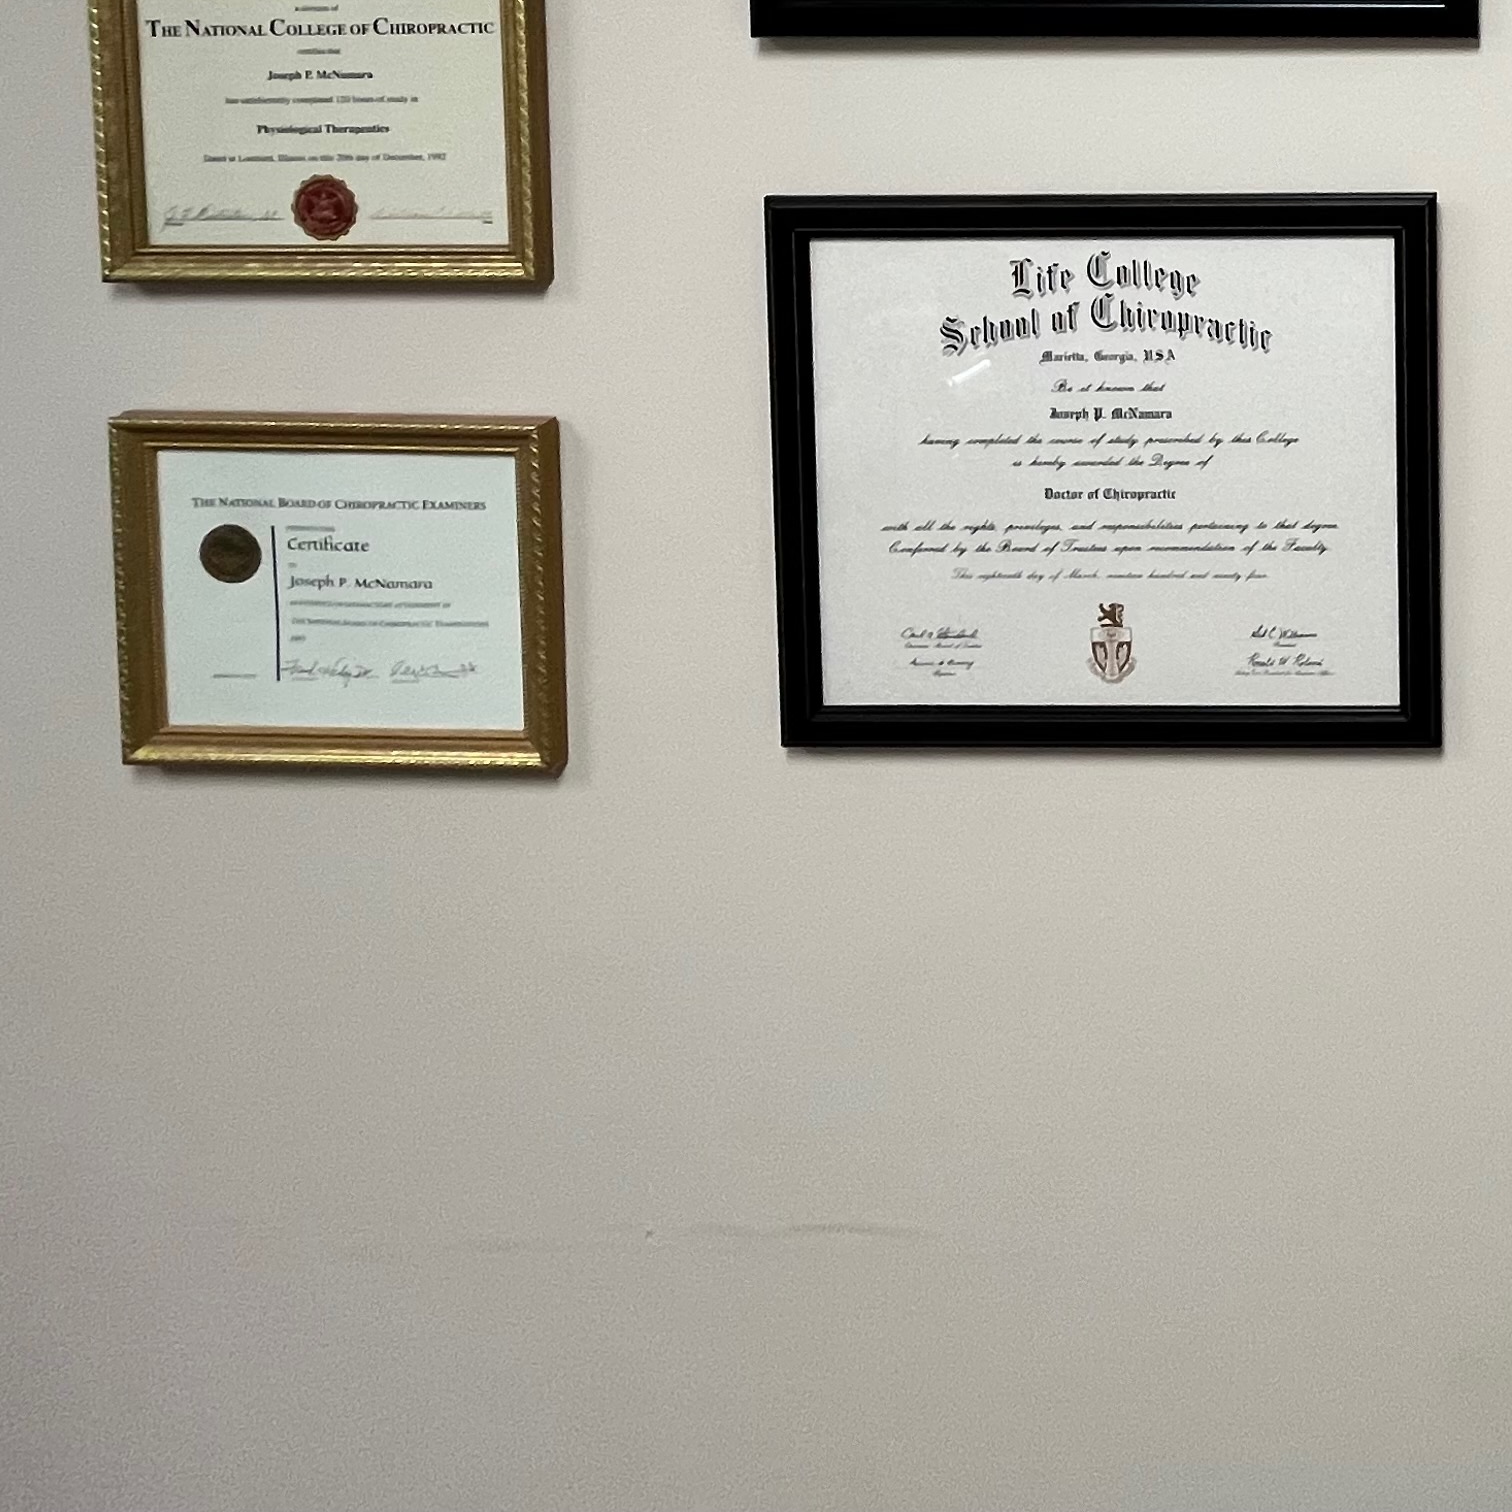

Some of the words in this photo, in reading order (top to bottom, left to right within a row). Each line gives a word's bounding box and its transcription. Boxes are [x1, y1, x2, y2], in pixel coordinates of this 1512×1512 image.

[145, 20, 181, 37] THE
[185, 20, 267, 36] NATIONAL
[270, 19, 347, 36] COLLEGE
[350, 24, 370, 35] OF
[373, 18, 493, 35] CHIROPRACTIC
[1010, 258, 1074, 299] Life
[1087, 251, 1200, 303] College
[940, 308, 1039, 356] School
[1052, 302, 1080, 334] of
[1091, 290, 1272, 357] Chiropractic
[1050, 408, 1089, 422] Joseph
[1112, 407, 1172, 419] McNamara
[1025, 434, 1042, 444] the
[1088, 433, 1107, 448] of
[1105, 433, 1138, 448] study
[1208, 433, 1223, 448] by
[1045, 488, 1083, 499] Doctor
[1088, 488, 1100, 499] of
[1103, 488, 1176, 501] Chiropractic
[288, 535, 369, 552] Certificate
[287, 574, 334, 590] Joseph
[355, 578, 432, 589] McNamara
